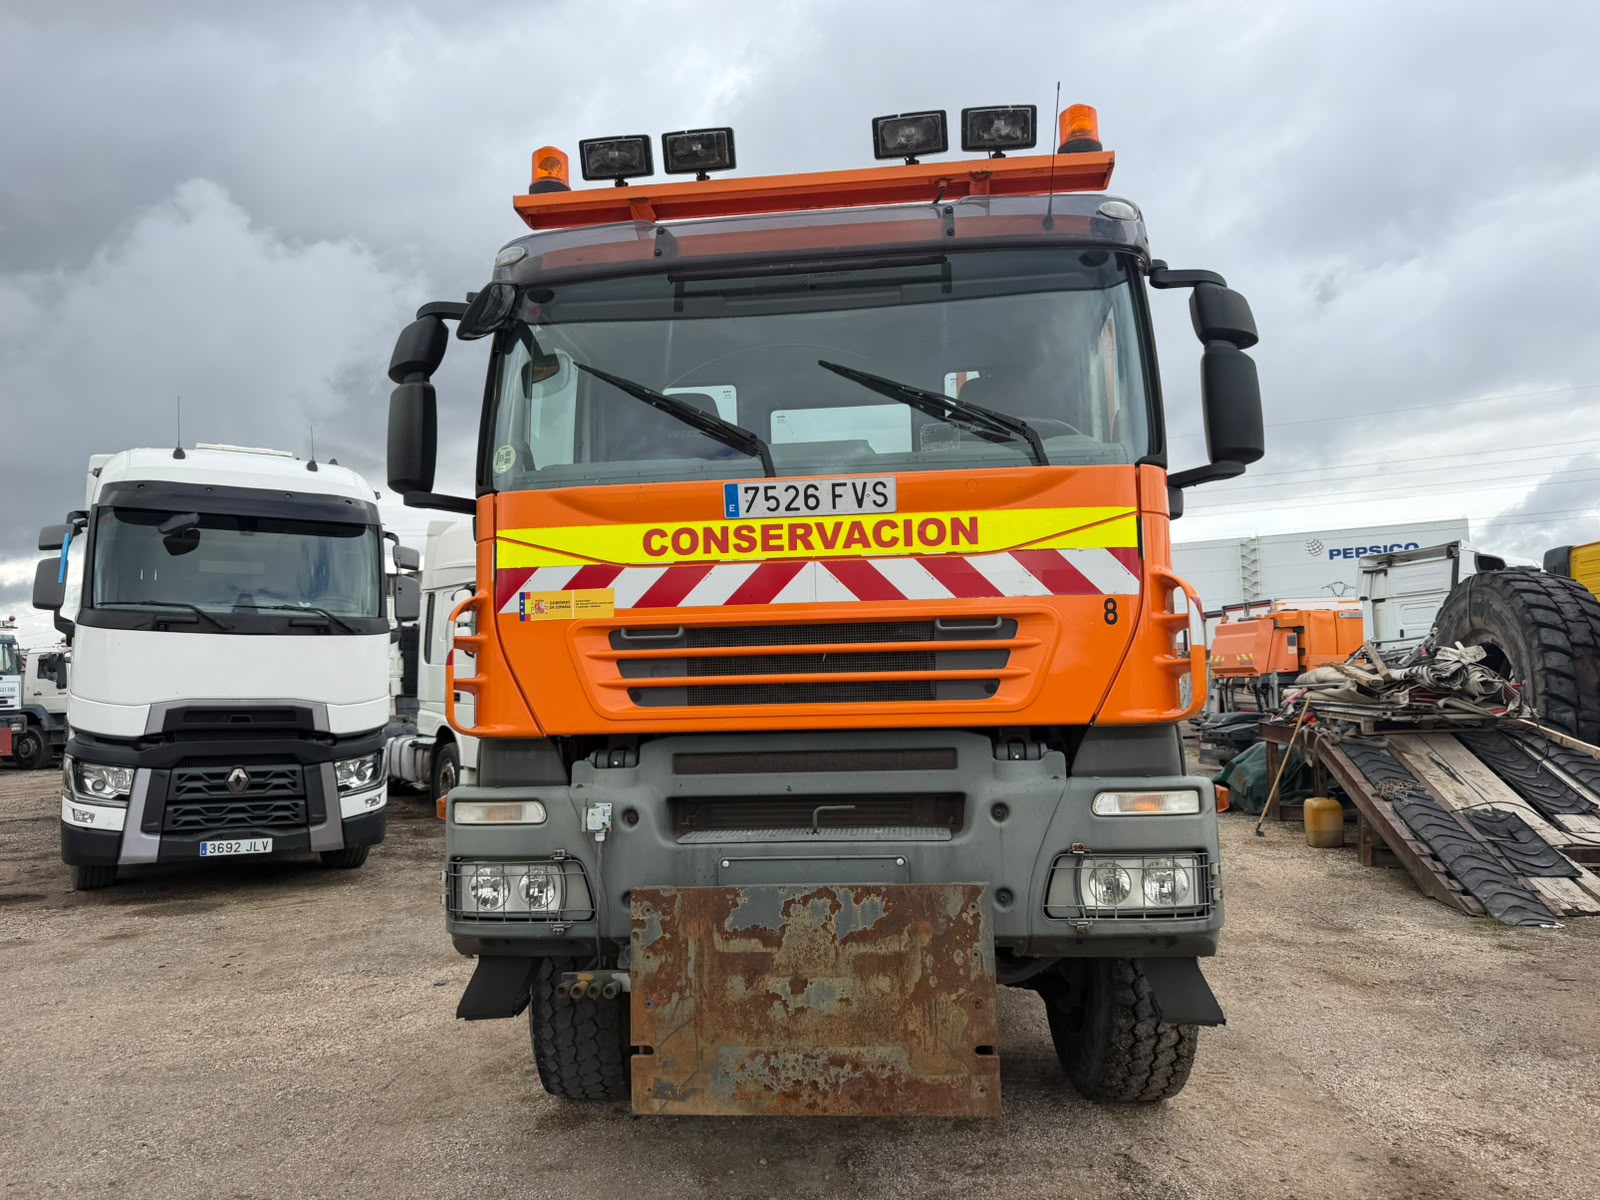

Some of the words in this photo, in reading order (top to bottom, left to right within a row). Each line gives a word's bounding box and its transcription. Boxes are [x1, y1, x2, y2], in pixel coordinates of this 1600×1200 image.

[743, 483, 821, 513] 7526
[831, 480, 889, 510] FVS
[729, 504, 736, 513] E
[642, 516, 979, 557] CONSERVACION
[1328, 542, 1420, 560] PEPSICO
[1103, 597, 1119, 626] 8
[209, 842, 241, 854] 3692
[246, 840, 269, 852] JLV
